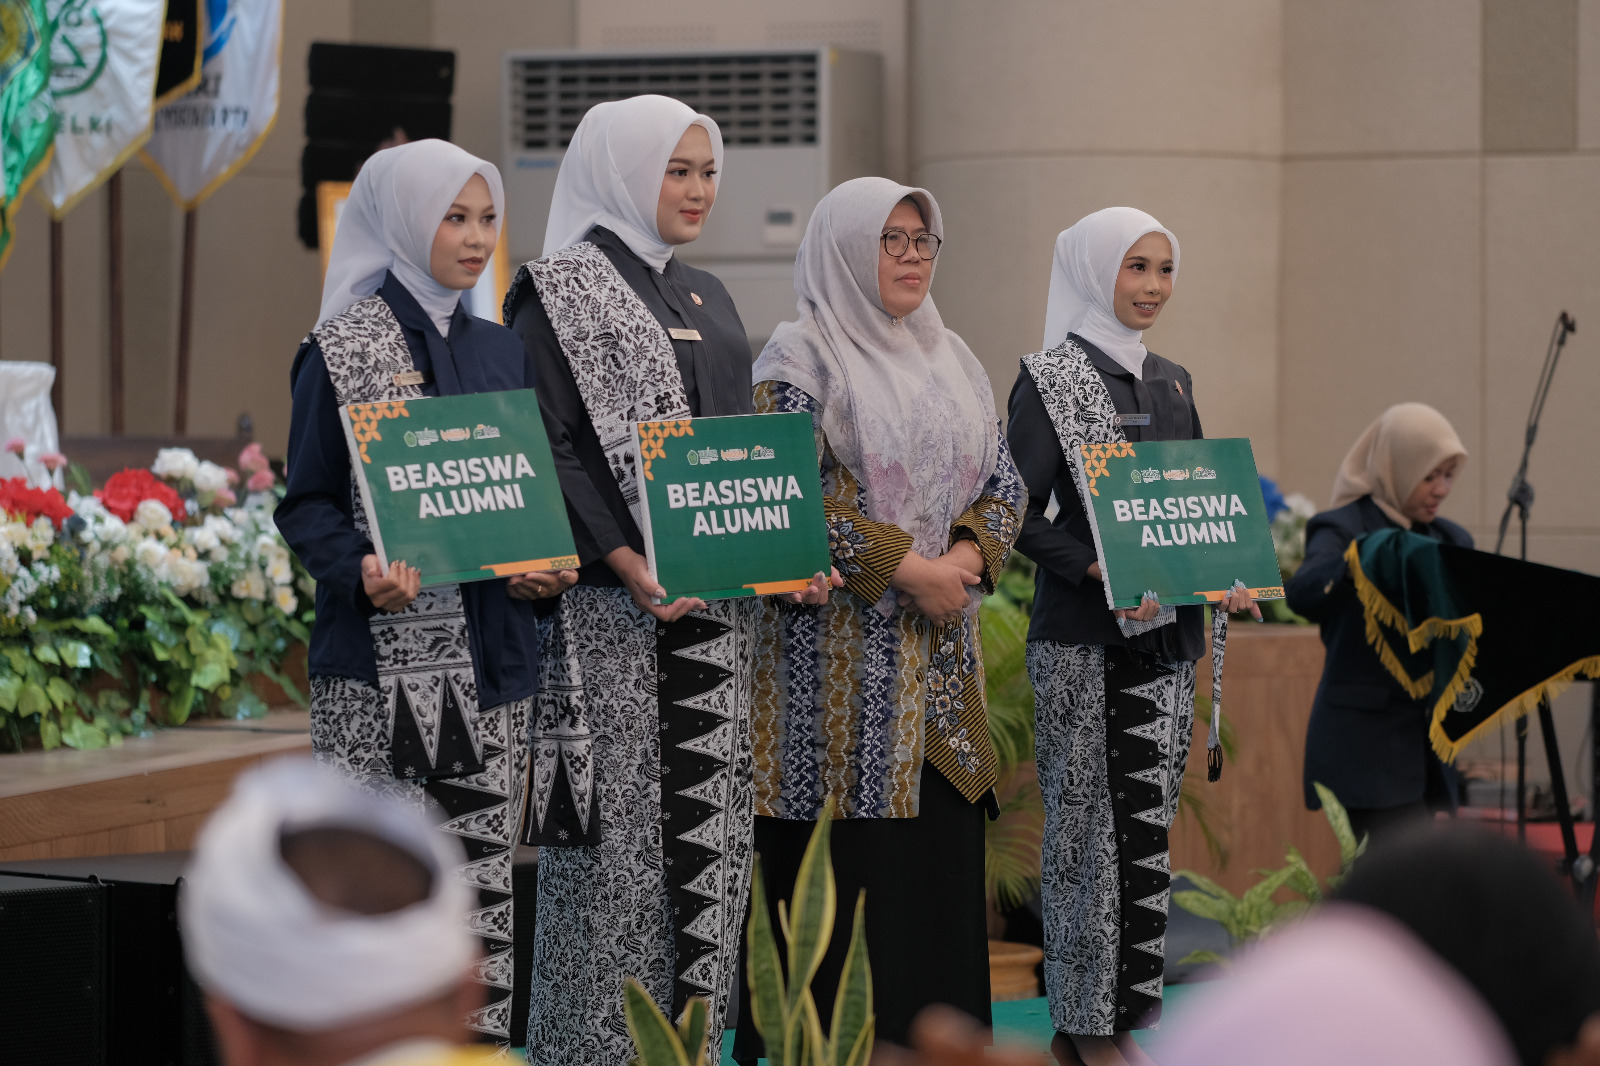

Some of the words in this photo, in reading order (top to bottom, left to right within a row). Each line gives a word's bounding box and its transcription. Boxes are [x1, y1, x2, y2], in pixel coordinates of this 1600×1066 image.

[385, 453, 536, 492] BEASISWA
[419, 483, 525, 519] ALUMNI
[666, 475, 804, 509] BEASISWA
[1112, 494, 1248, 522] BEASISWA
[692, 504, 790, 537] ALUMNI
[1141, 520, 1236, 547] ALUMNI
